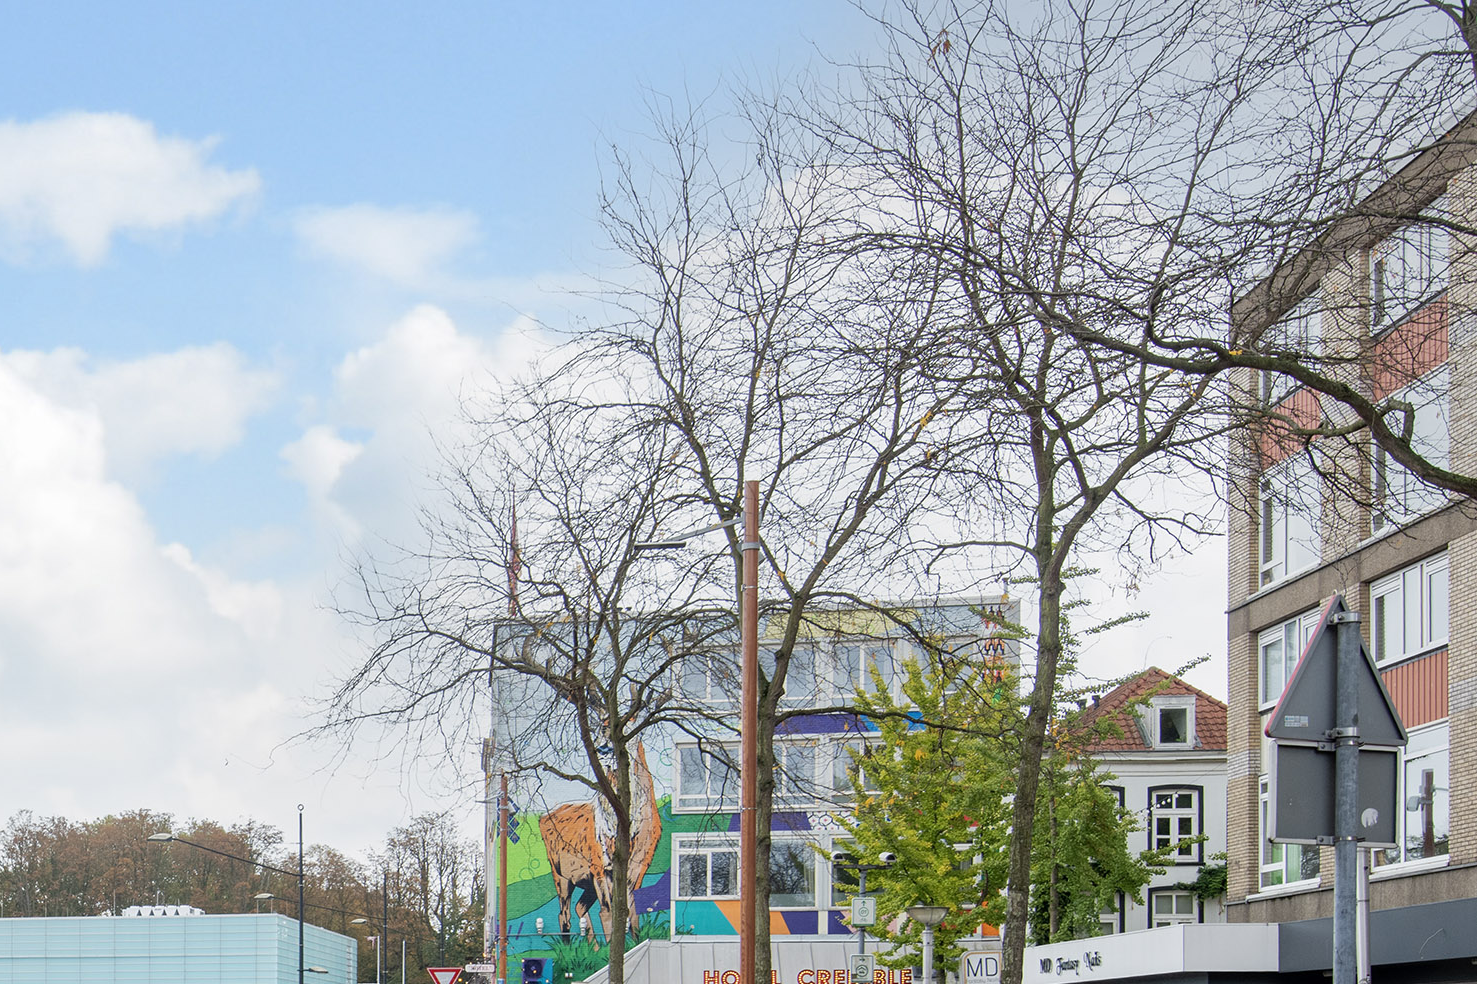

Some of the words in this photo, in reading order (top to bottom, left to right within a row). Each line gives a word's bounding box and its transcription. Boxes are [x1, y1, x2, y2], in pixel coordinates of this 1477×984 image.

[966, 957, 998, 977] MD
[1039, 957, 1053, 974] MD
[1056, 957, 1080, 976] Fantasy
